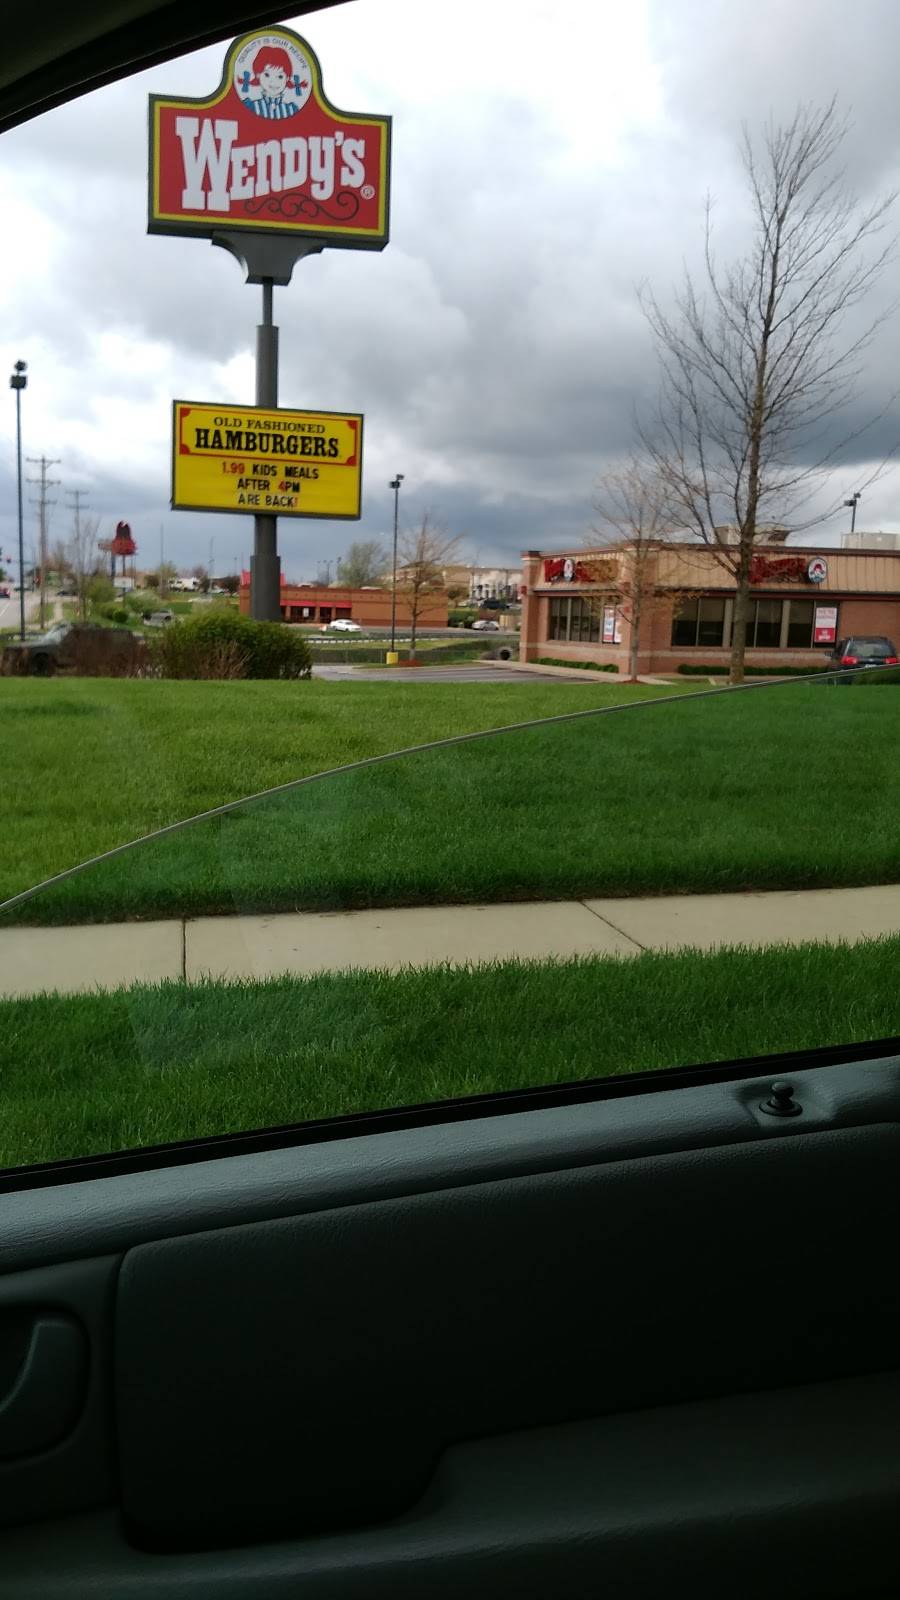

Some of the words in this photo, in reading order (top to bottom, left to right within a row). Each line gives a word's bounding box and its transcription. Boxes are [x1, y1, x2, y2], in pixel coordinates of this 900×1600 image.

[272, 38, 289, 47] OUR
[289, 45, 308, 70] RECIPE
[214, 416, 242, 428] OLD
[246, 419, 326, 434] FASHIONED
[195, 428, 339, 458] HAMBURGERS
[222, 461, 246, 475] 1.99
[252, 464, 277, 477] KIDS
[285, 465, 320, 479] MEALS
[237, 478, 271, 491] AFTER
[278, 480, 300, 493] 4PM
[238, 493, 260, 506] ARE
[265, 494, 299, 507] BACK!
